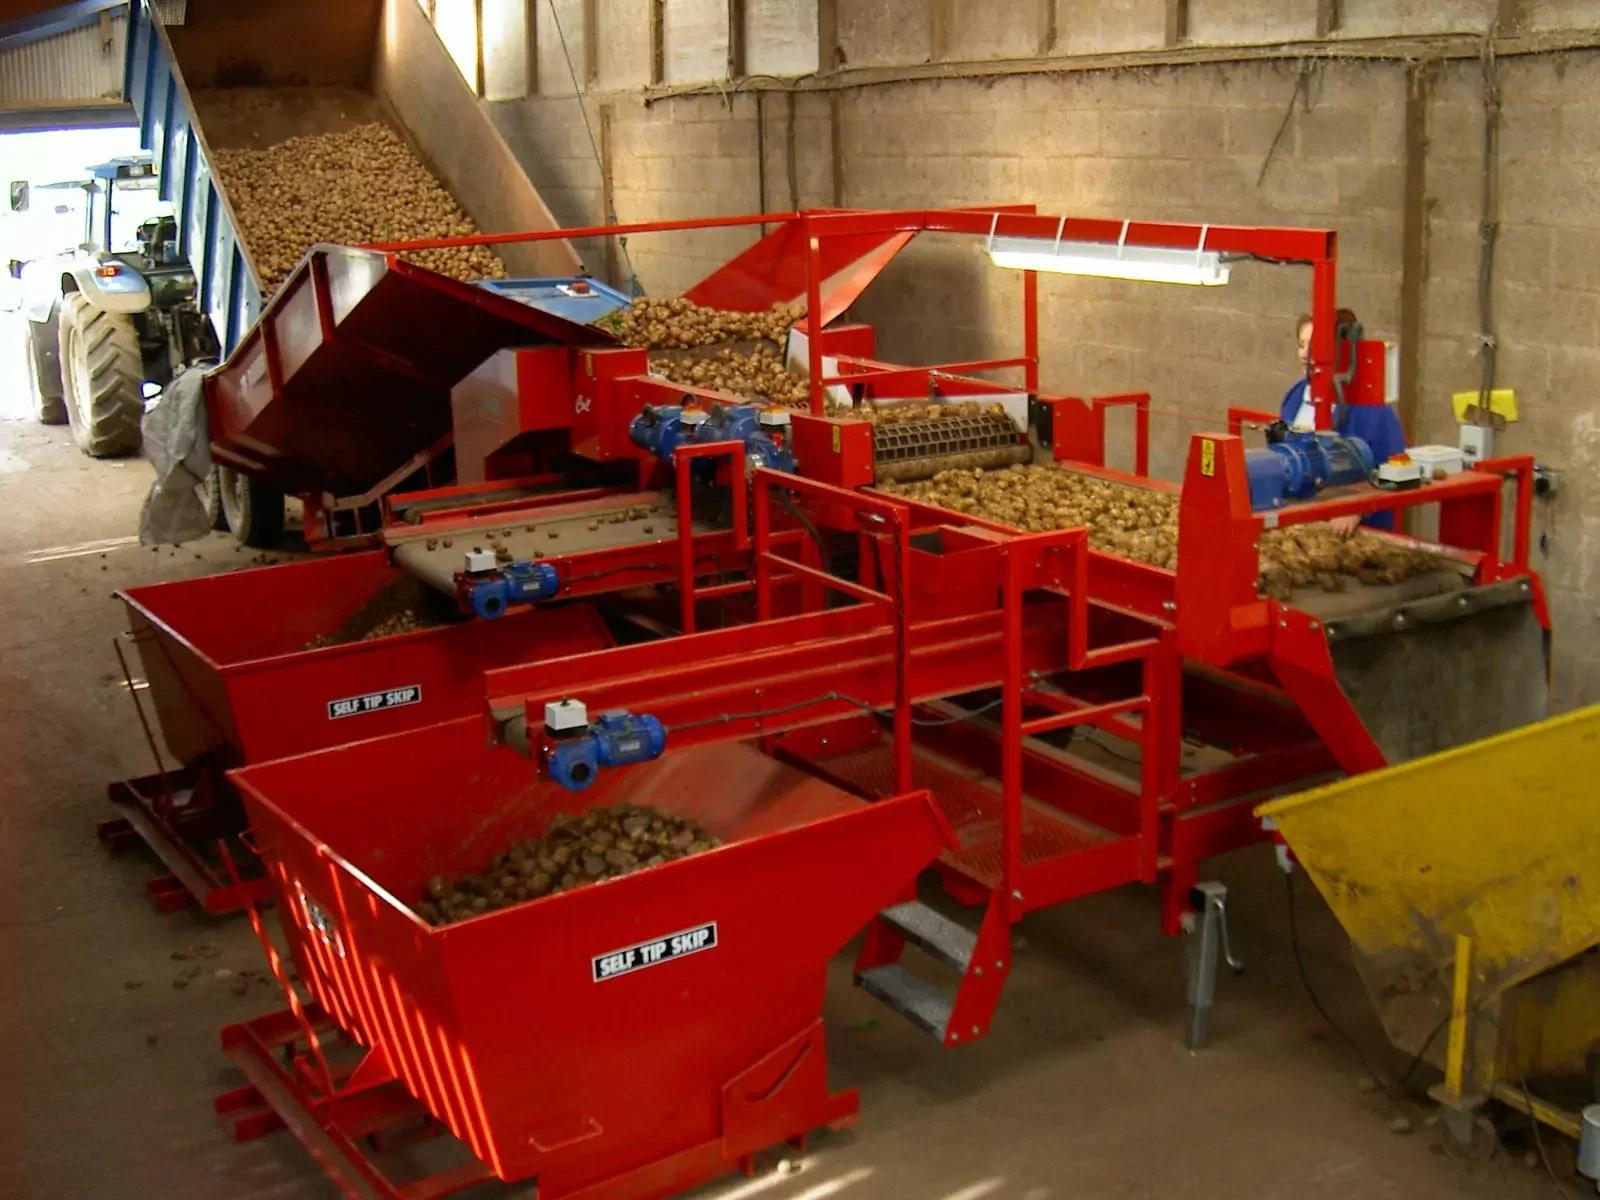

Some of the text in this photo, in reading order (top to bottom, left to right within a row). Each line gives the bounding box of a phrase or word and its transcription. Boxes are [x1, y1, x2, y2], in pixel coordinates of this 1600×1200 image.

[333, 689, 415, 716] SELF TIP SKIP
[600, 928, 710, 977] SELF TIP SKIP
